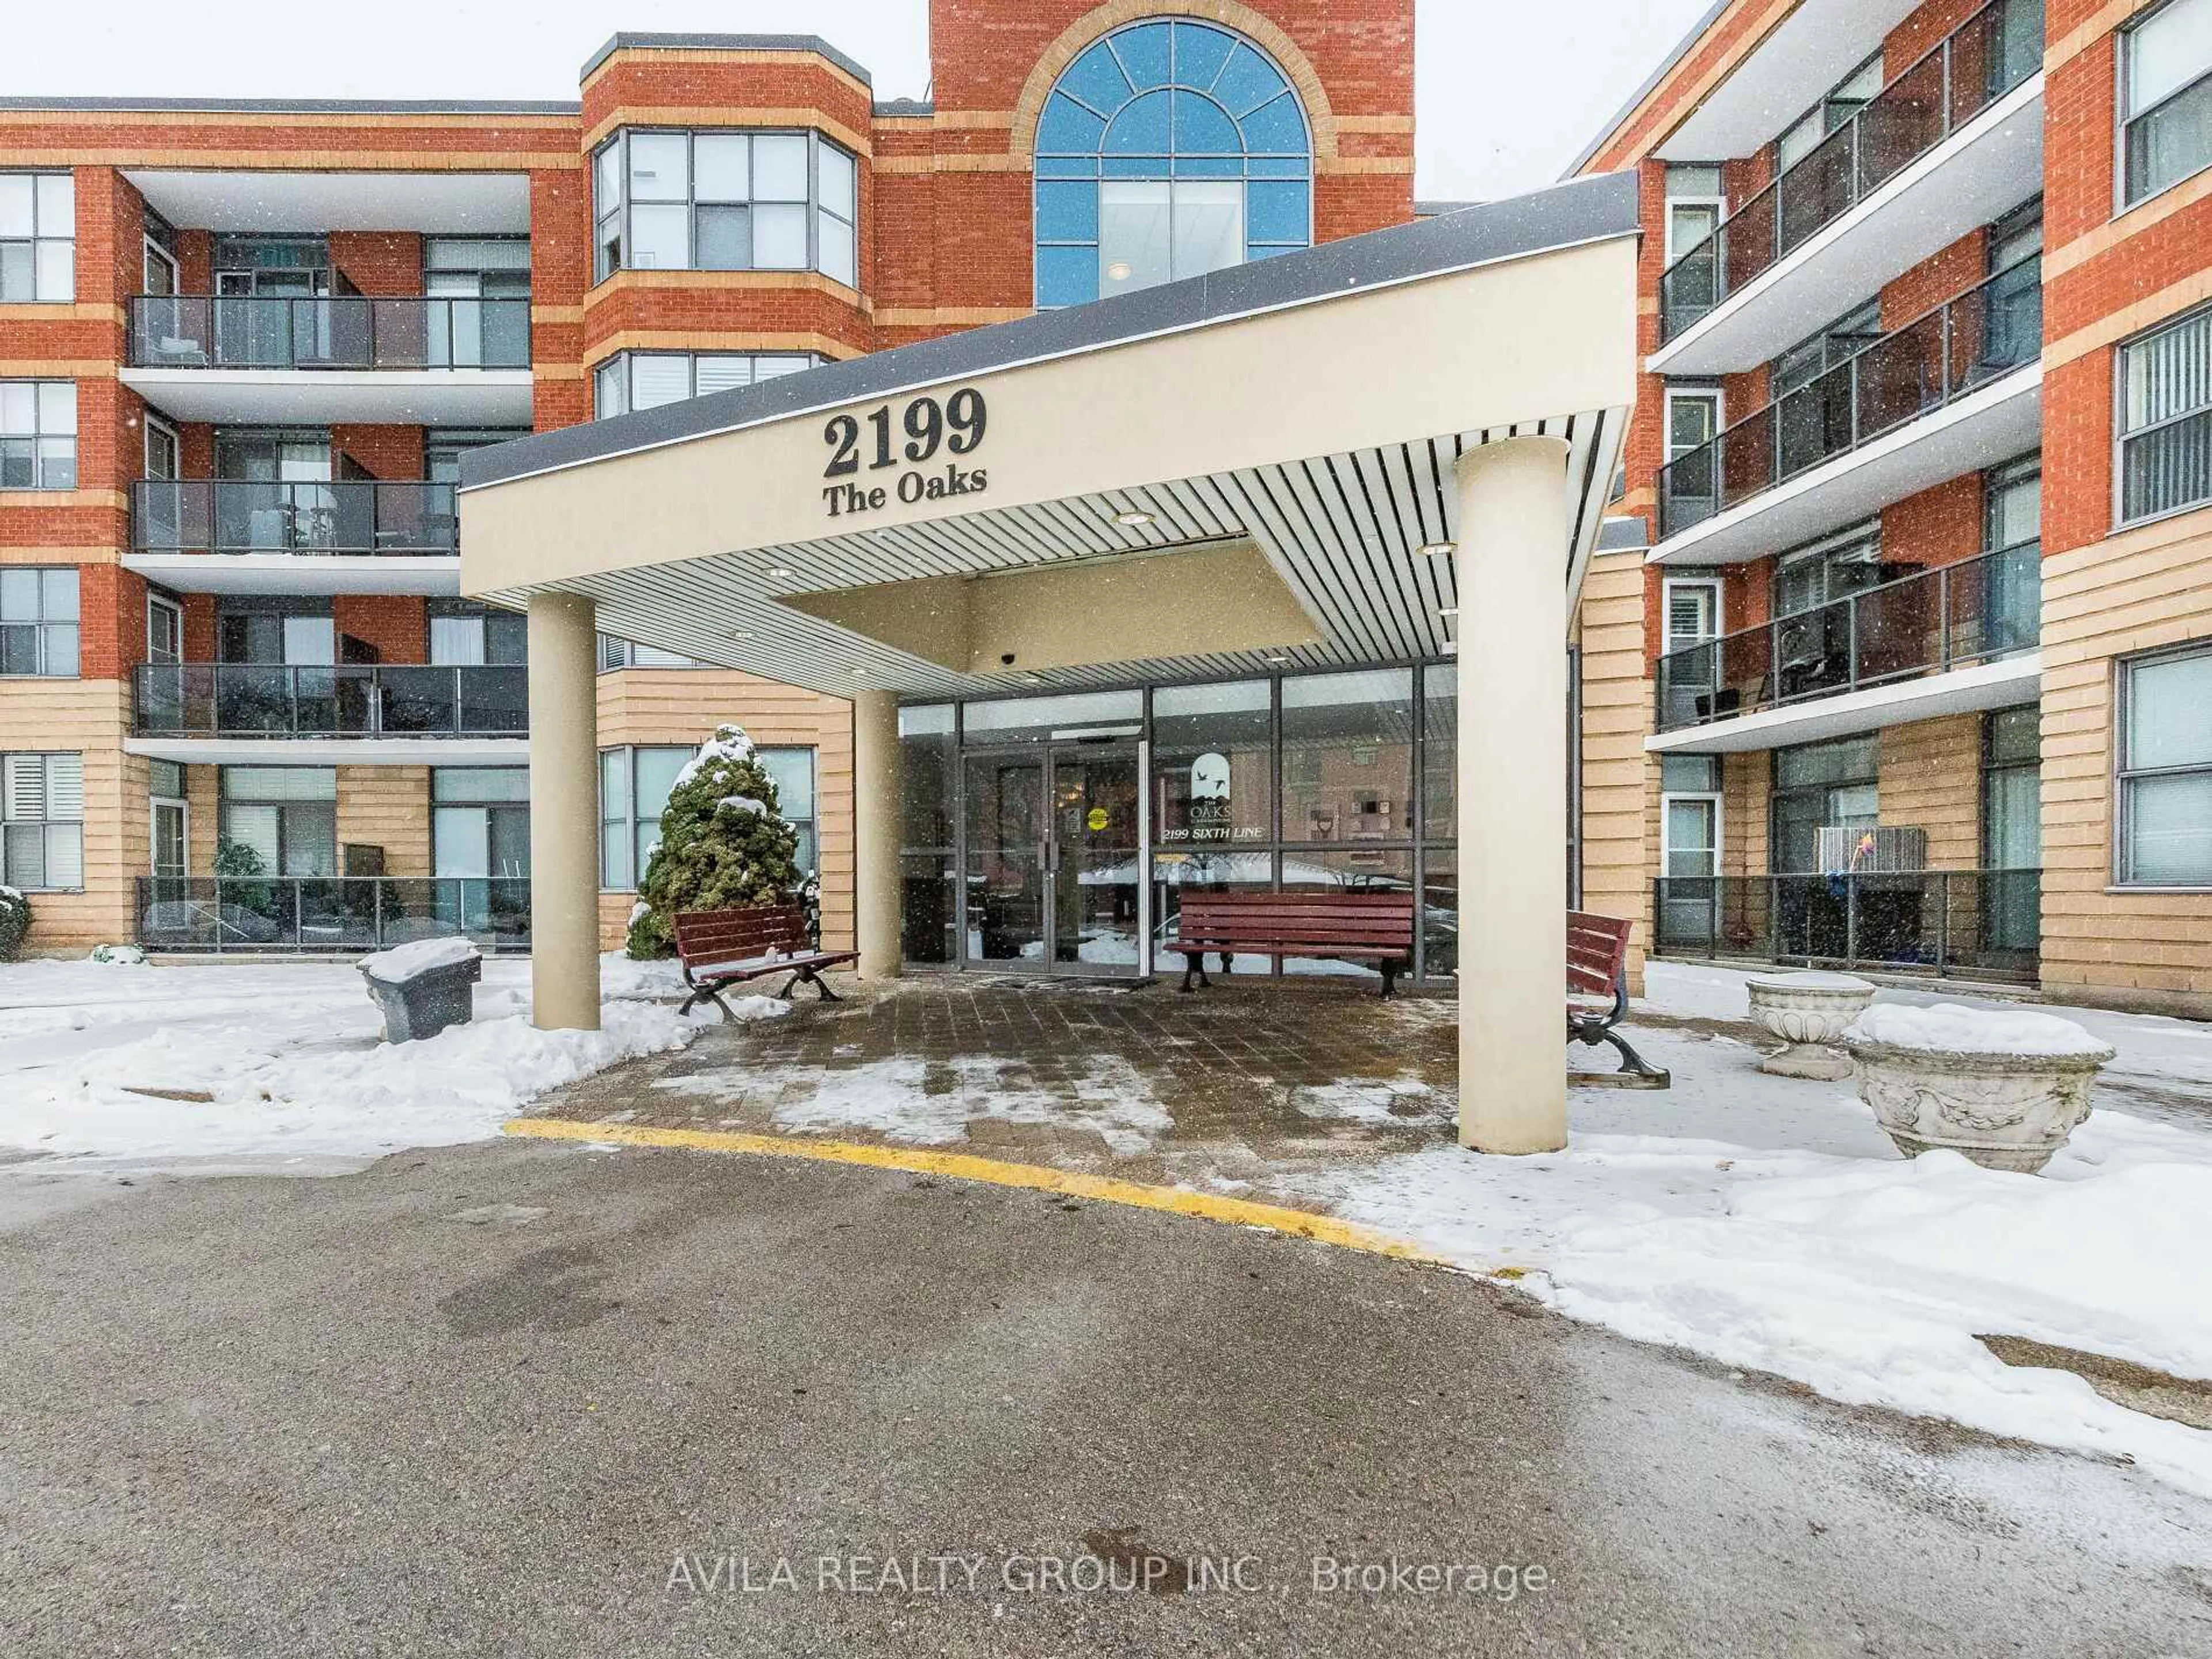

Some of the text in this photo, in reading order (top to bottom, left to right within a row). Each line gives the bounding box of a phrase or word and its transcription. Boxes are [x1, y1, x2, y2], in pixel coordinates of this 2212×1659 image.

[823, 388, 987, 478] 2199
[822, 464, 987, 516] The Oaks
[1191, 806, 1232, 818] OAKS
[1164, 827, 1264, 839] 2199 SIXTH LINE
